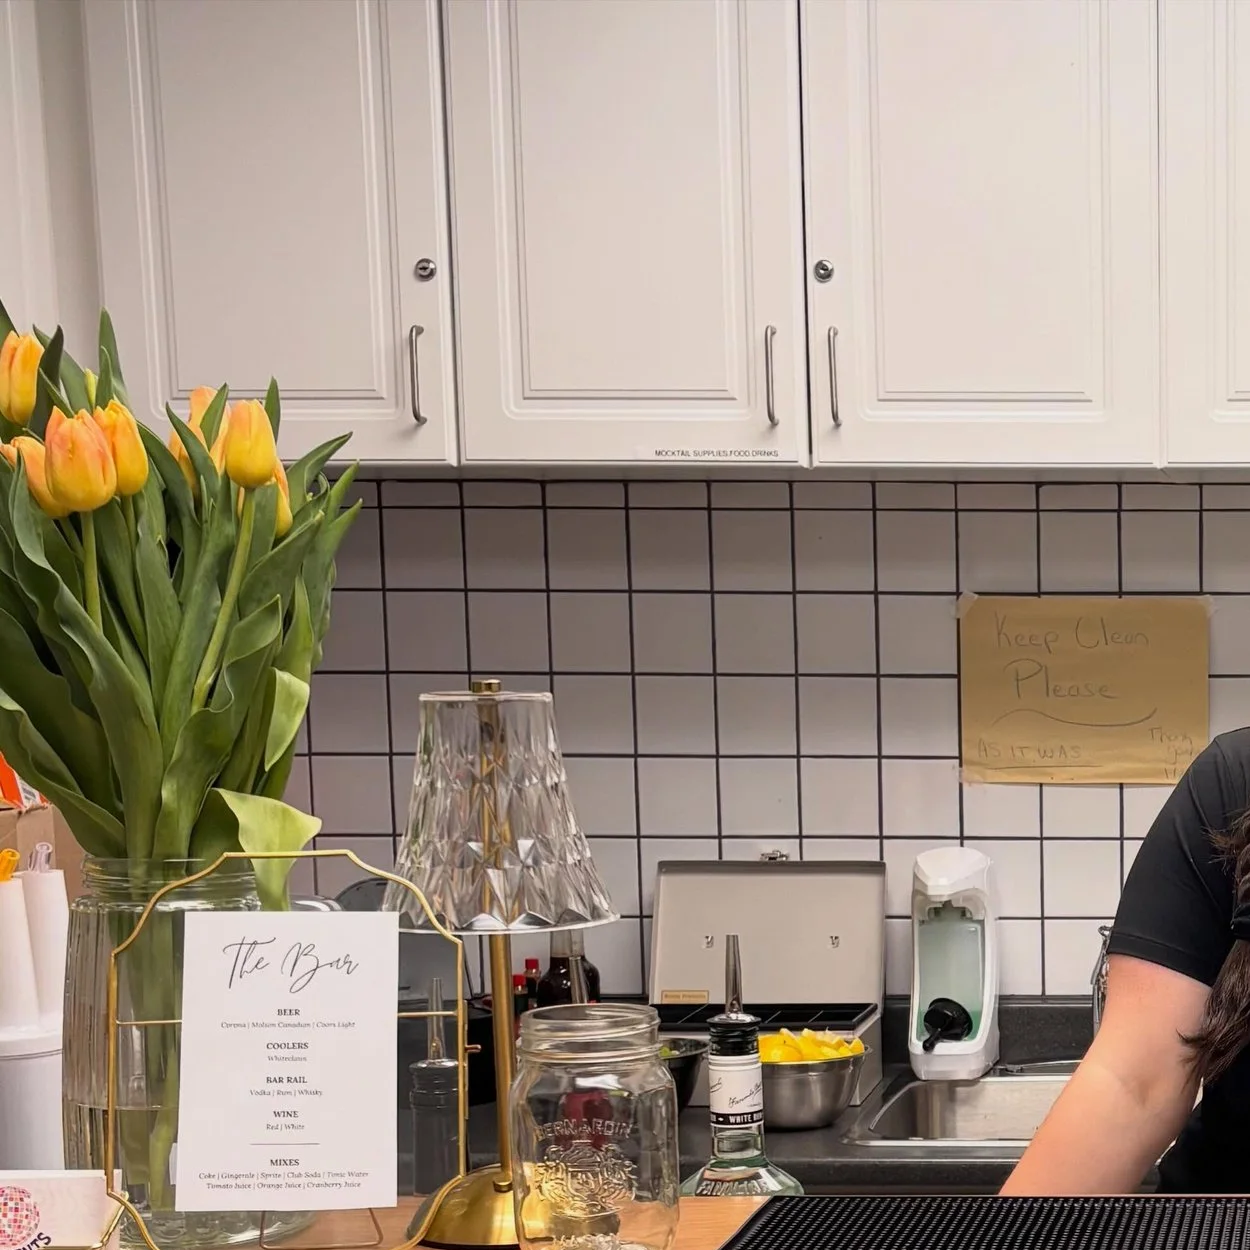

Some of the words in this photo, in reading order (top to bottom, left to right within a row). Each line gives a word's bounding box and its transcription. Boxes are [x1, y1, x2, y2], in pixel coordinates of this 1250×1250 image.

[993, 612, 1059, 654] Keep
[1075, 616, 1149, 649] Clean
[1003, 658, 1119, 699] Please
[977, 737, 1000, 759] AS
[222, 936, 277, 989] The
[281, 942, 359, 994] Bar
[277, 1008, 301, 1016] BEER
[266, 1042, 309, 1050] COOLERS
[266, 1076, 284, 1084] BAR
[286, 1076, 308, 1084] RAIL
[198, 1172, 216, 1180] Coke
[260, 1172, 281, 1180] Sprite
[286, 1171, 302, 1179] Club
[206, 1182, 233, 1190] Tomato
[257, 1182, 283, 1190] Orange
